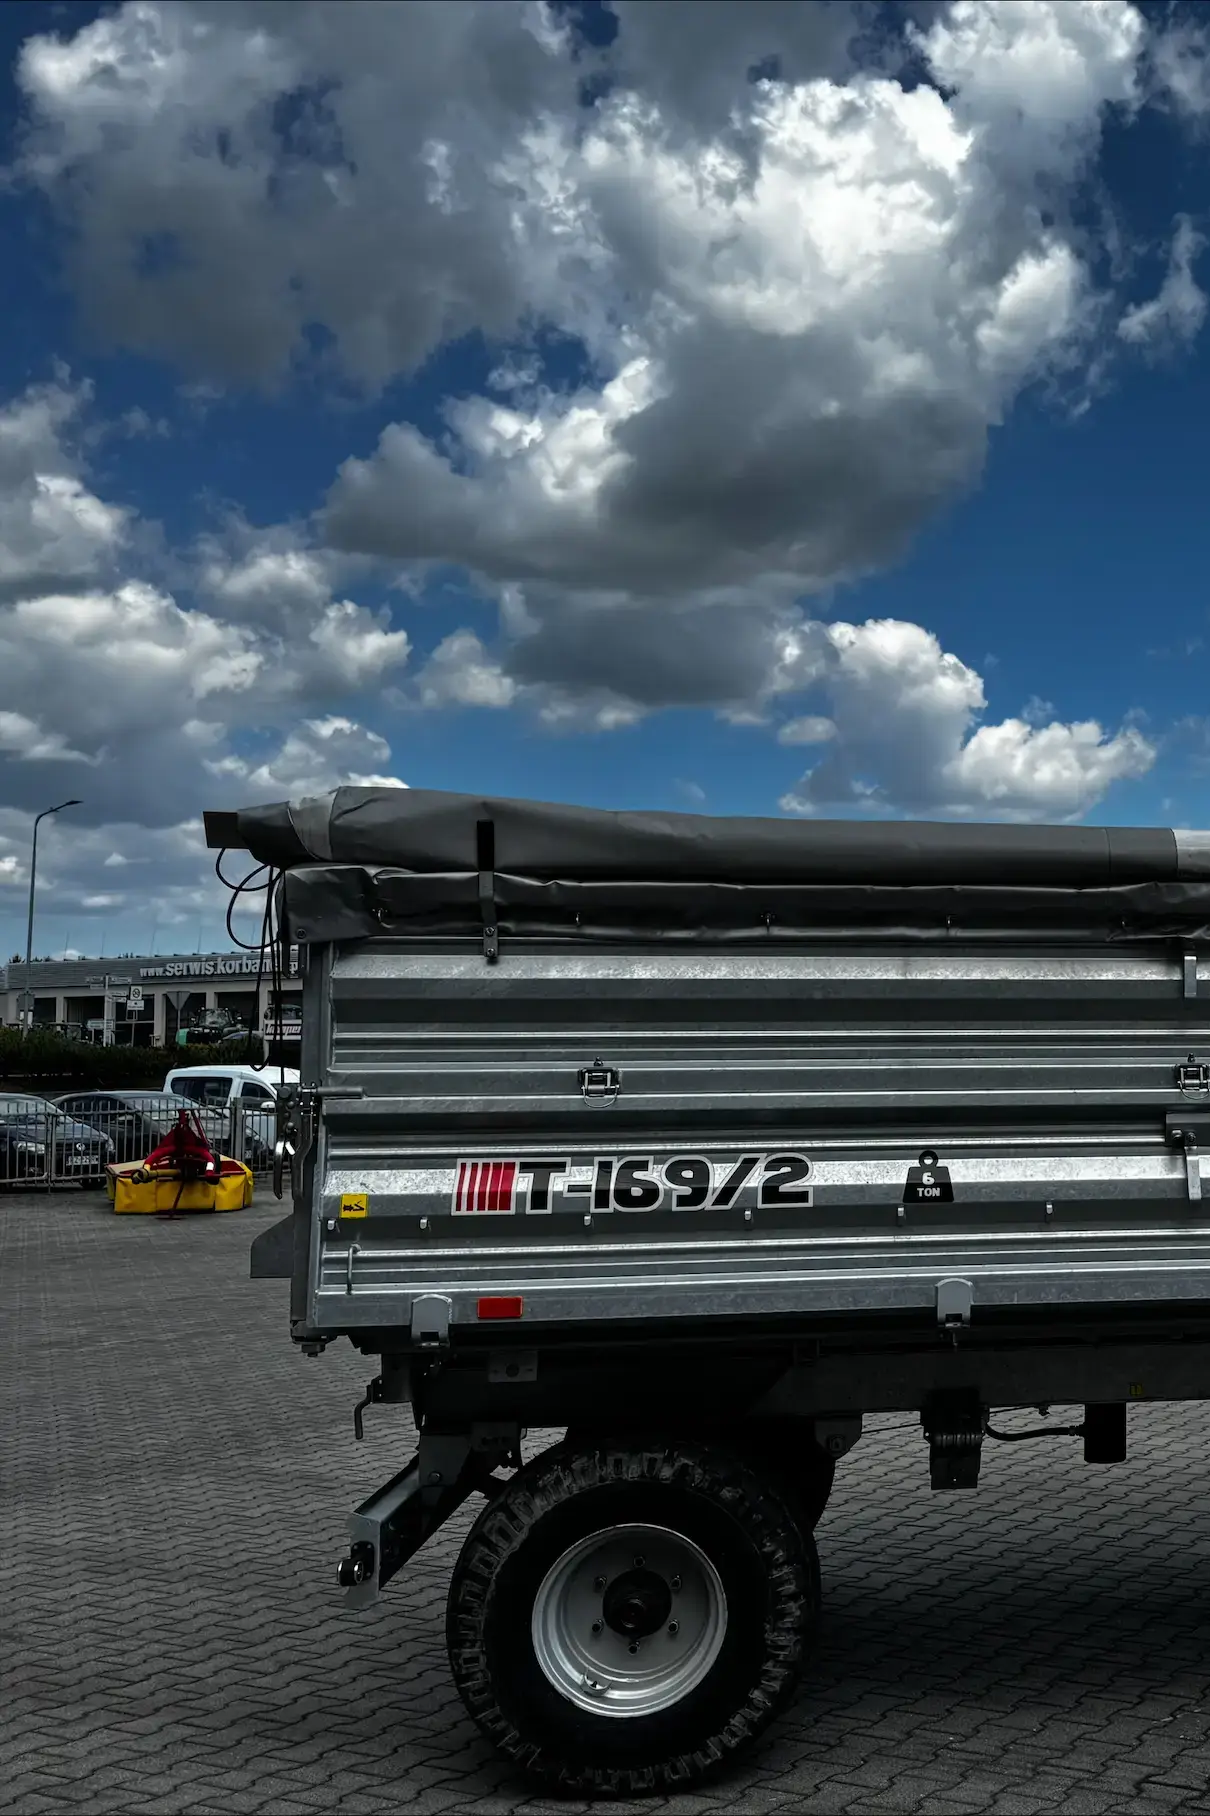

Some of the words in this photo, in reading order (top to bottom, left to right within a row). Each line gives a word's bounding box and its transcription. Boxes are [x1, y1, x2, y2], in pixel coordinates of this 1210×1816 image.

[517, 1153, 814, 1215] T-169/2
[922, 1171, 935, 1185] 6
[916, 1187, 941, 1197] TON
